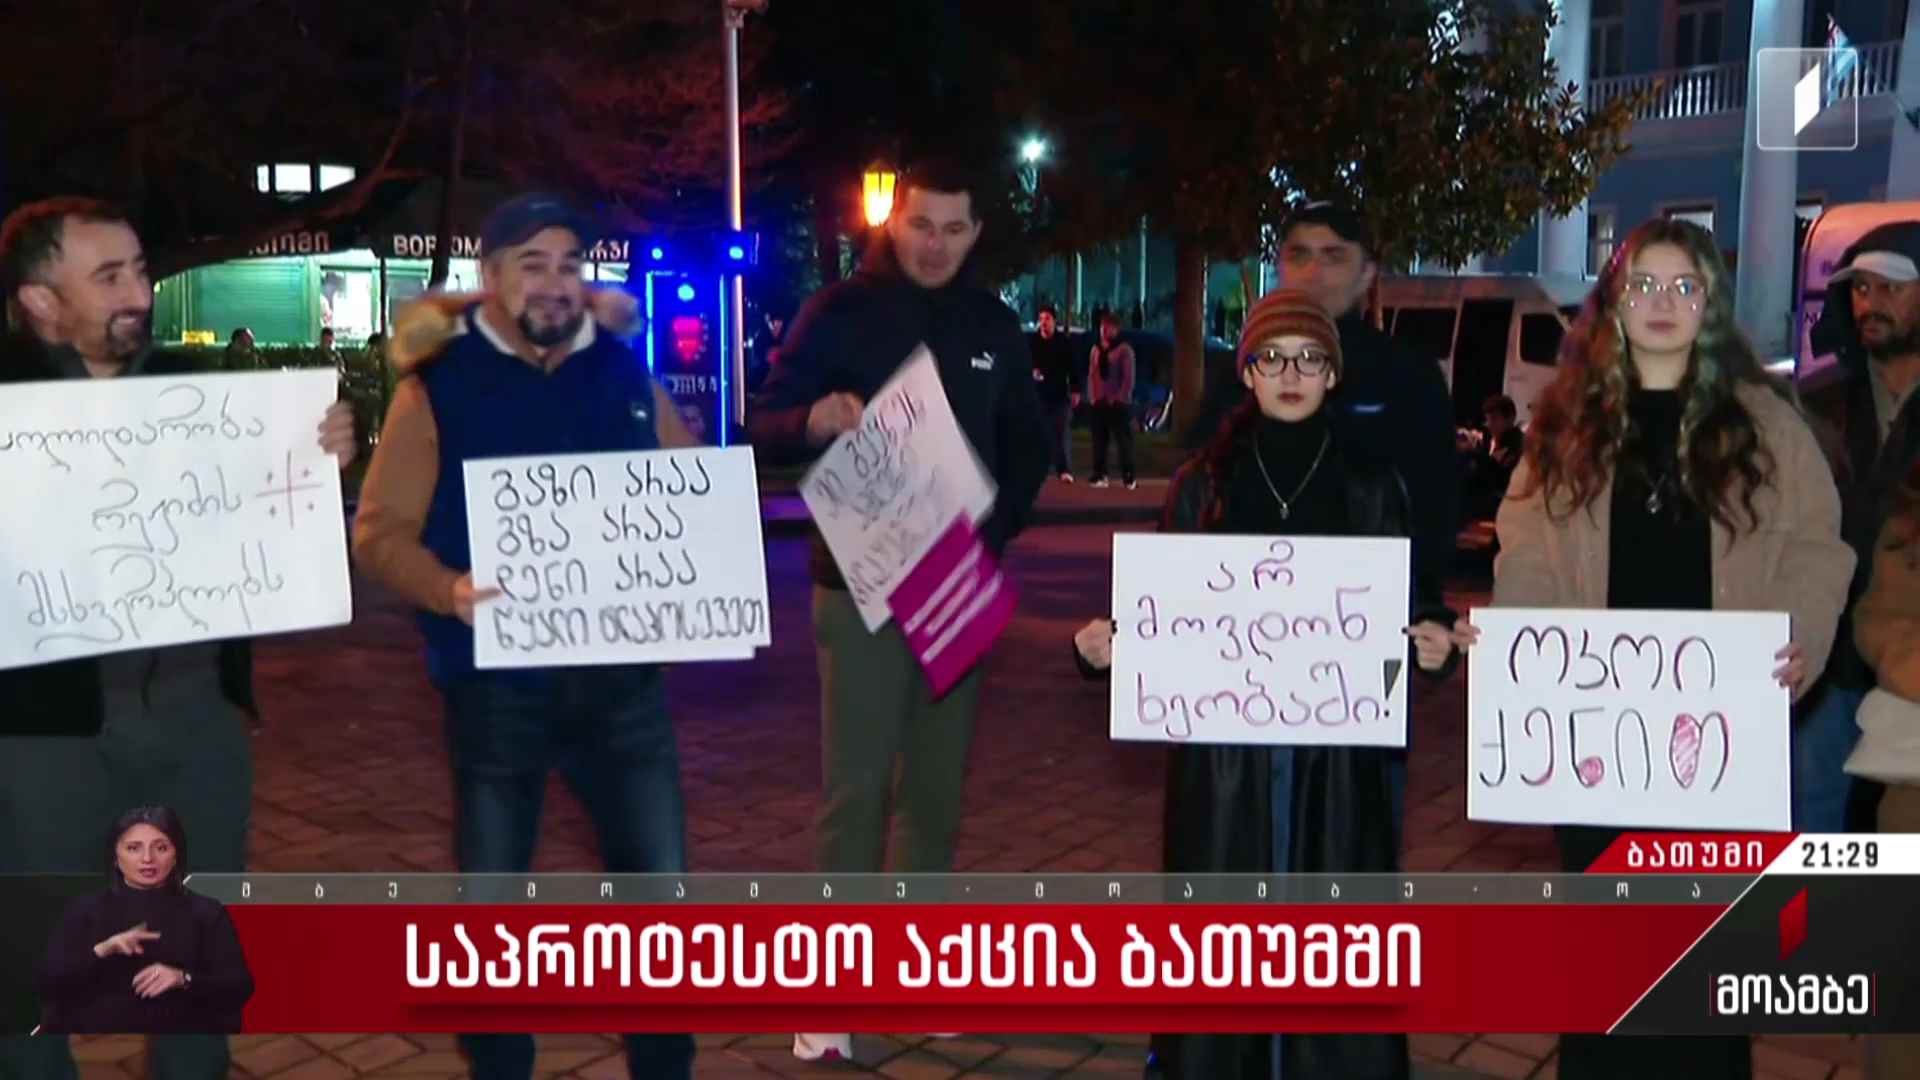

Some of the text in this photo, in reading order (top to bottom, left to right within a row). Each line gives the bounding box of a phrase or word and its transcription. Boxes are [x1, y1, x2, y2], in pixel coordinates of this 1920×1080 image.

[492, 456, 711, 511] გაზი არაა
[497, 502, 684, 556] გზა არაა
[496, 549, 697, 603] დენი არაა
[1207, 540, 1295, 591] არ
[1137, 585, 1371, 662] მოვდონ
[1479, 706, 1731, 792] ქენით
